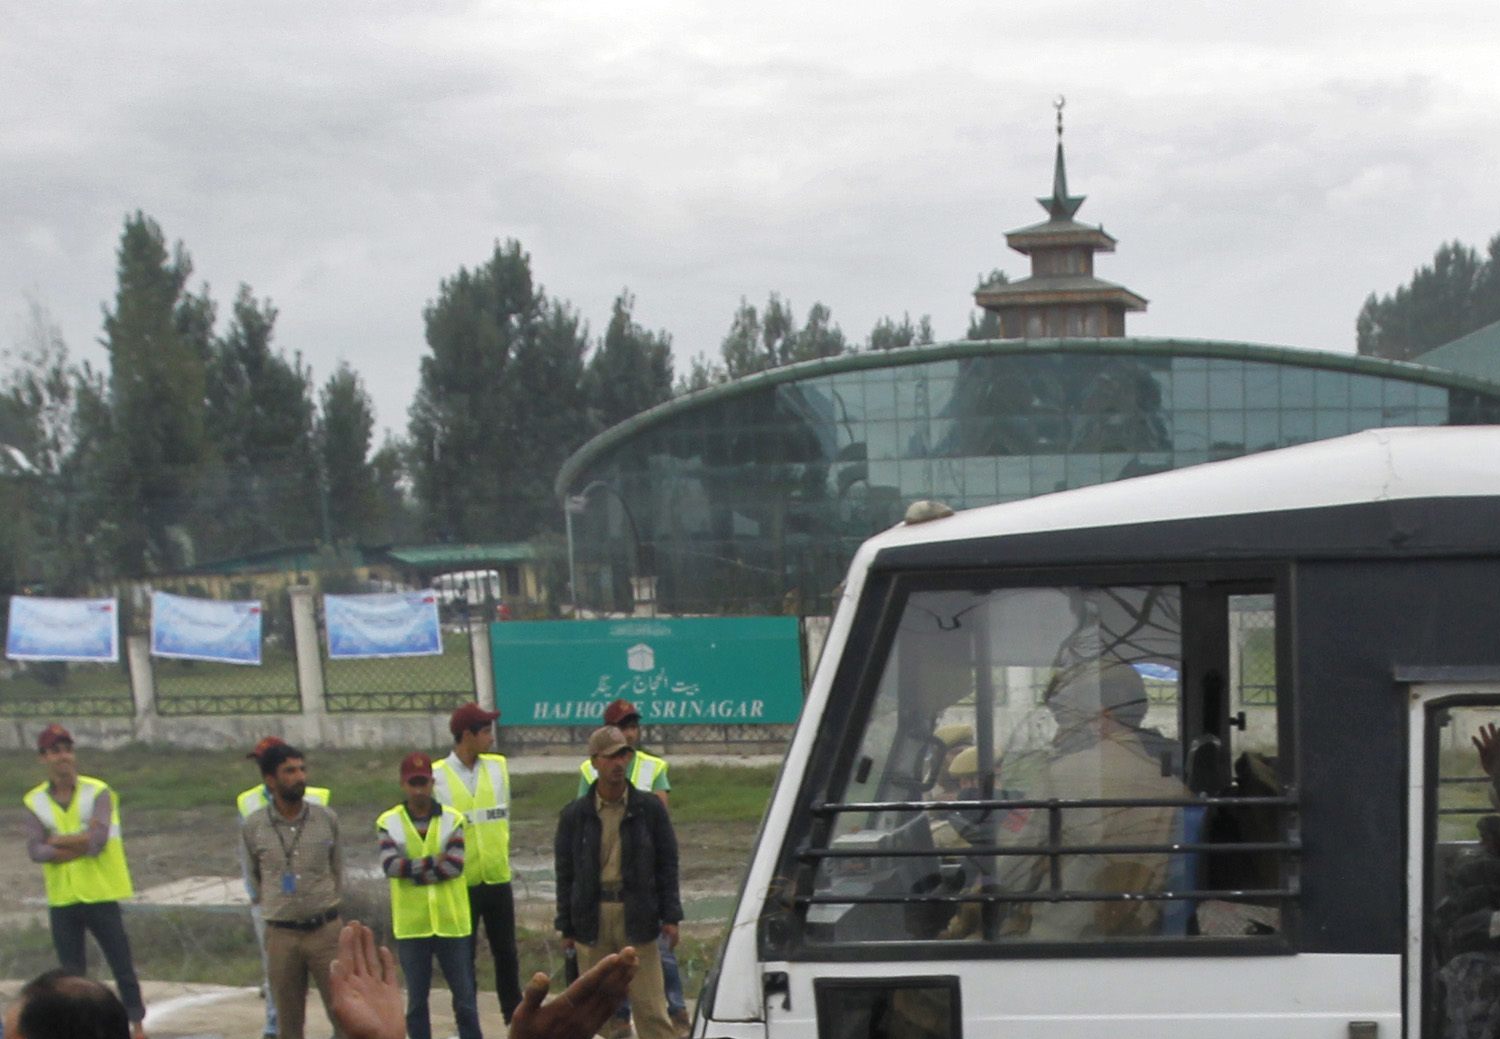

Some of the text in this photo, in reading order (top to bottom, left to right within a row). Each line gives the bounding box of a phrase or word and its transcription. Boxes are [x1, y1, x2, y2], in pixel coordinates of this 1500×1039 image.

[533, 699, 766, 720] HAJ HOE SRINAGAR
